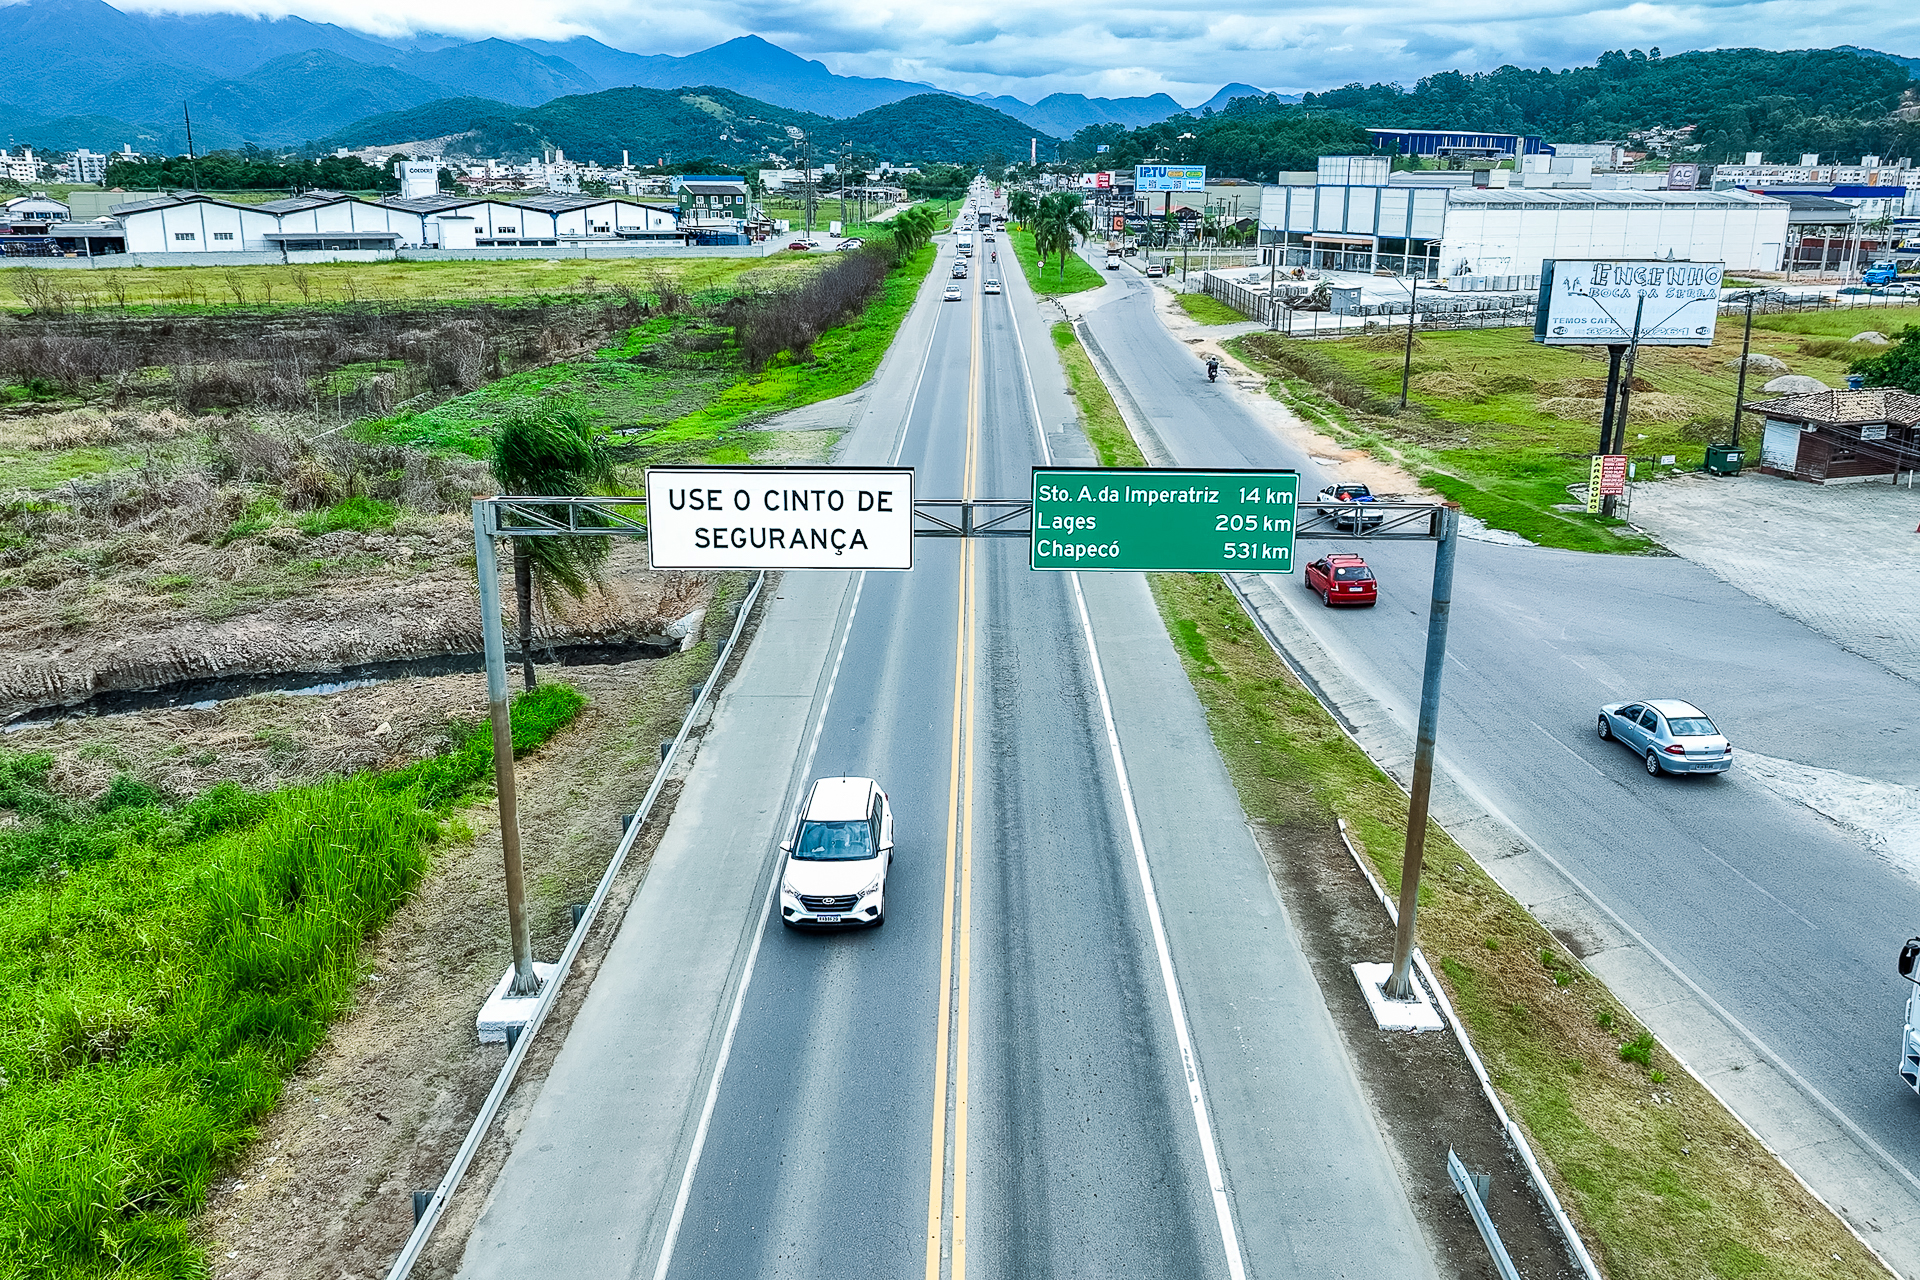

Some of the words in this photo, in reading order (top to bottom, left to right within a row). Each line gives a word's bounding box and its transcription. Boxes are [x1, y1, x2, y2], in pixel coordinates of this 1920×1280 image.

[1140, 166, 1167, 178] IPTU
[1590, 262, 1723, 287] ENGENHO
[1589, 288, 1631, 299] BOCA
[1637, 288, 1659, 299] DA
[1665, 288, 1718, 299] SERRA
[1552, 317, 1588, 325] TEMOS
[1589, 456, 1601, 509] PARADOURO
[669, 488, 723, 511] USE
[733, 489, 750, 511] O
[764, 489, 844, 512] CINTO
[858, 490, 893, 513] DE
[1039, 485, 1073, 502] Sto.
[1125, 486, 1220, 507] Imperatriz
[1239, 487, 1261, 504] 14
[1266, 487, 1293, 504] km
[1037, 512, 1096, 535] Lages
[1215, 514, 1258, 532] 205
[1263, 515, 1291, 532] km
[694, 527, 869, 556] SEGURANÇA
[1037, 539, 1120, 562] Chapecó
[1223, 542, 1258, 559] 531
[1261, 542, 1289, 559] km
